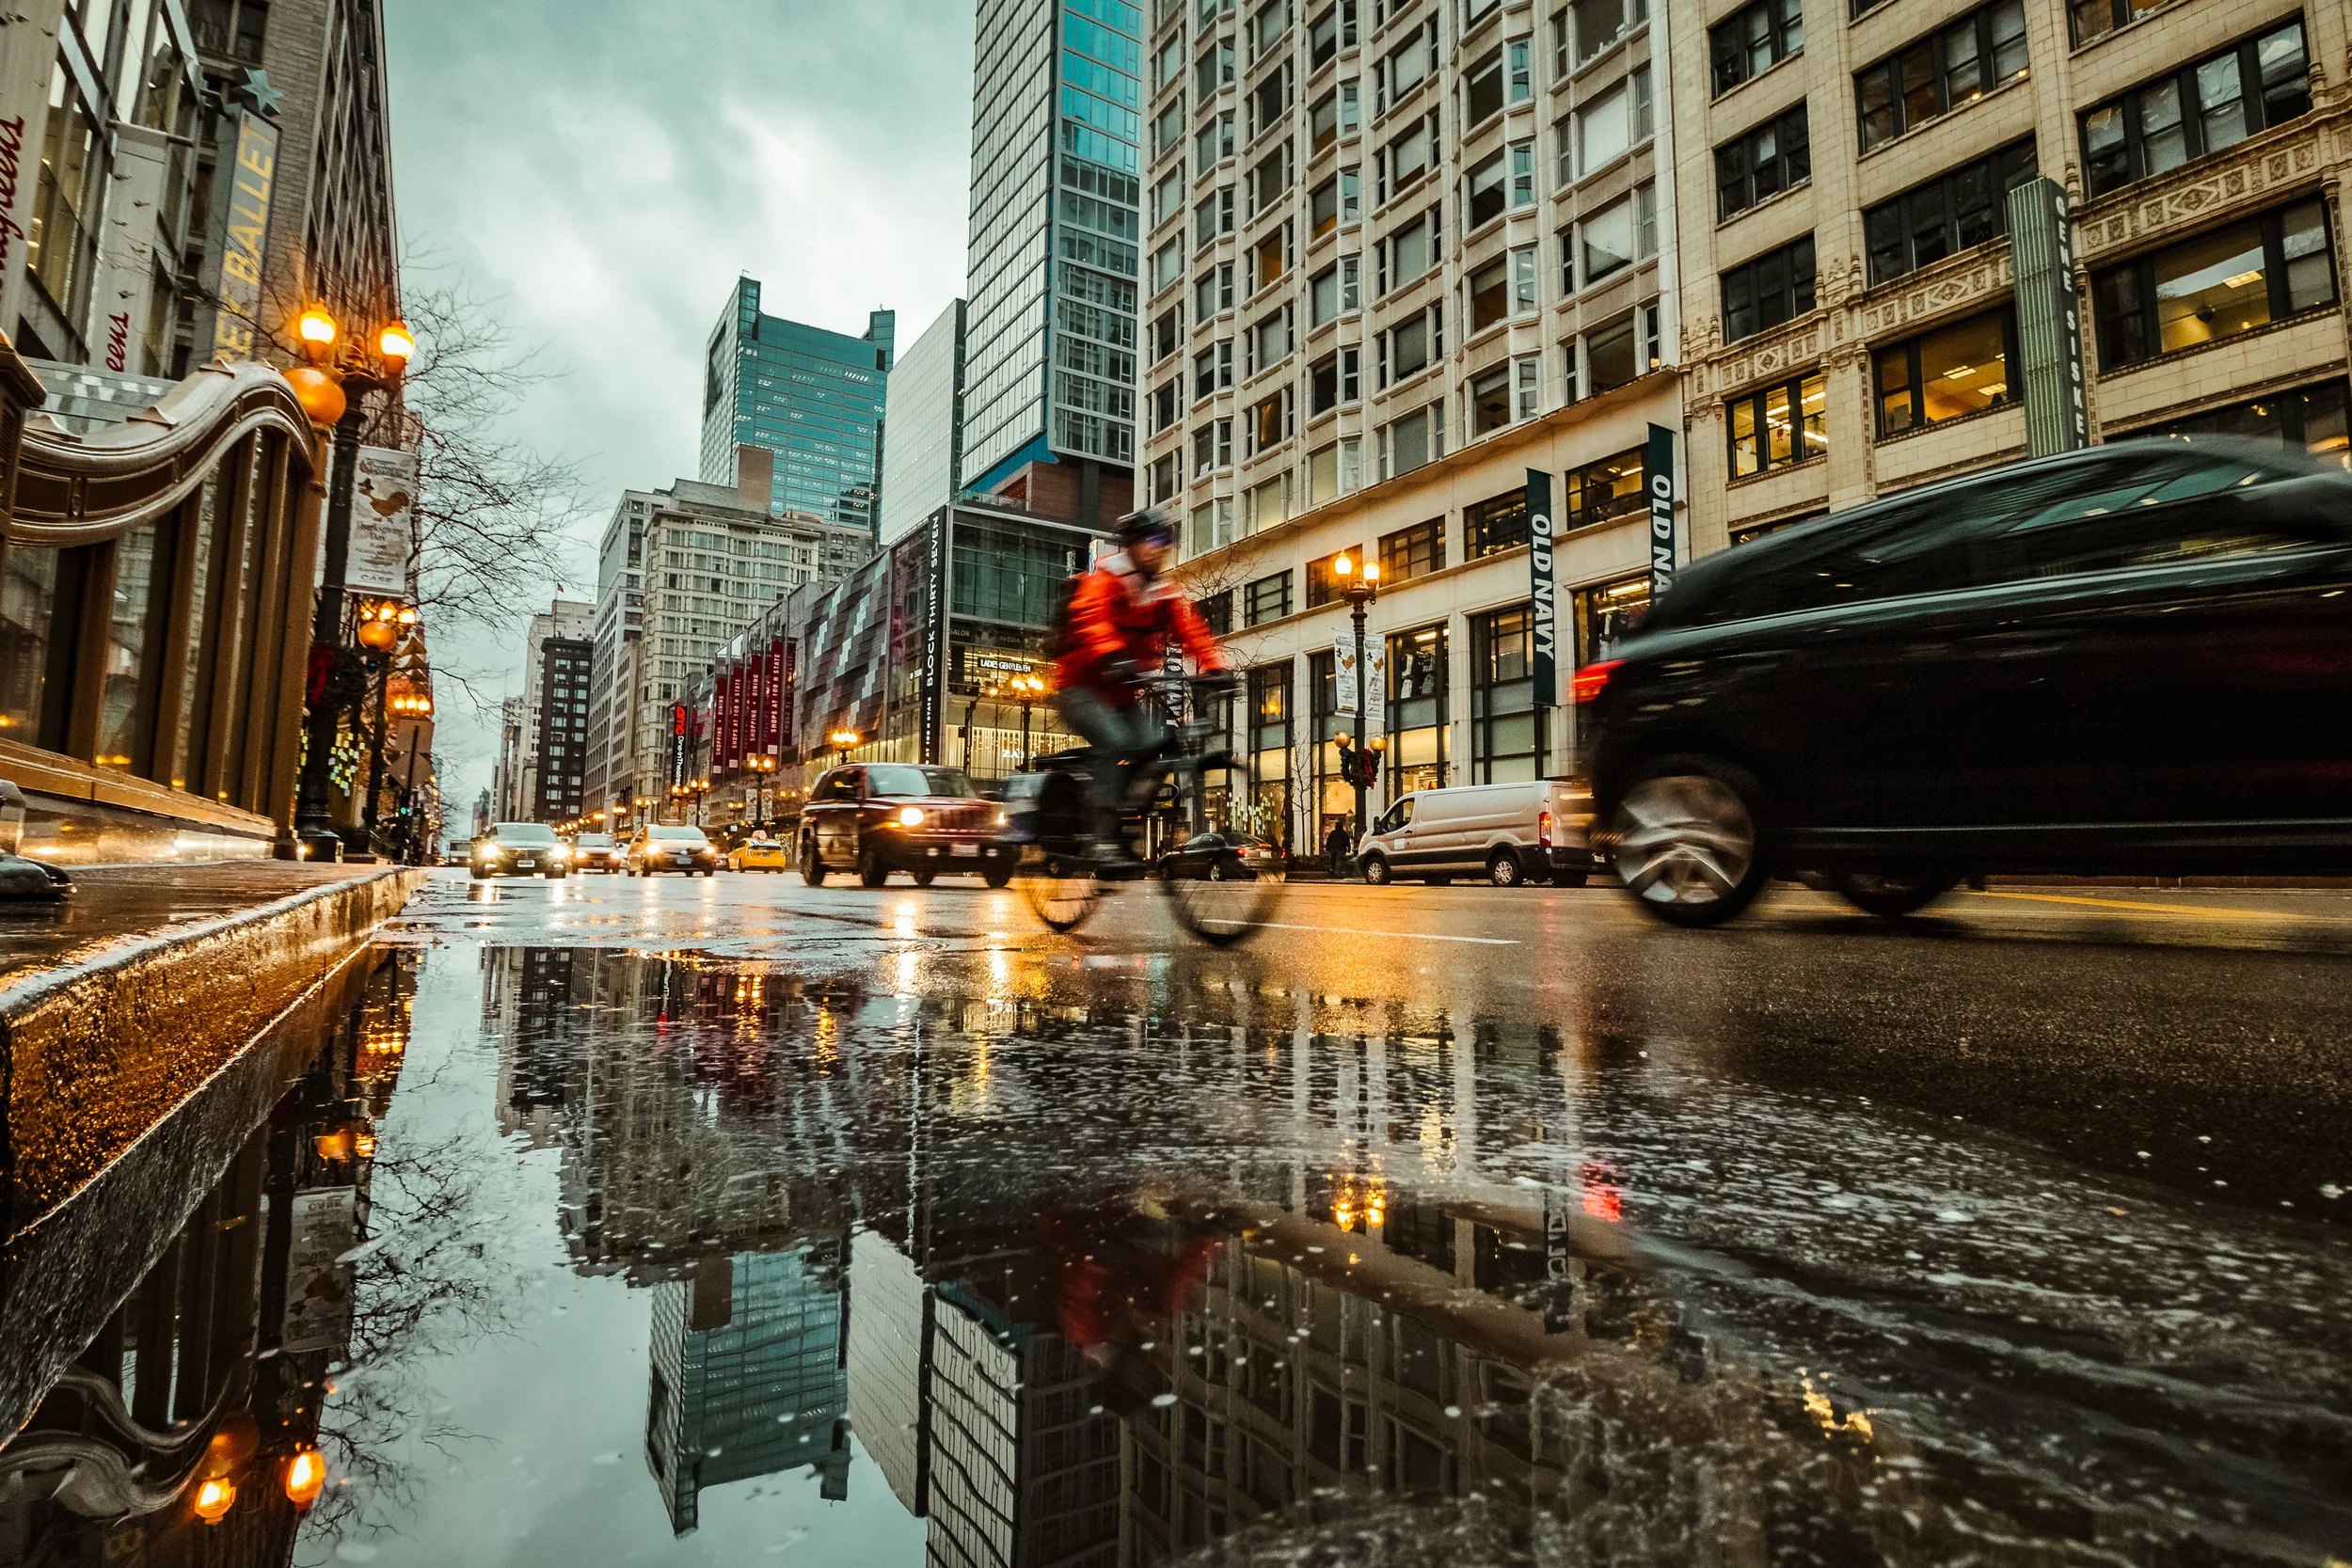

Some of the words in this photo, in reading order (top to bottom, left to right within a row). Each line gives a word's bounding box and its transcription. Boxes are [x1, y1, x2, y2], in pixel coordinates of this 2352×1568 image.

[223, 115, 275, 286] BALLET
[2055, 196, 2073, 293] GENE
[1652, 473, 1672, 540] OLD
[930, 515, 939, 568] SEVEN
[1532, 514, 1552, 573] OLD
[929, 573, 937, 627] THIRTY
[1653, 545, 1673, 603] NA
[948, 627, 970, 638] SALON
[999, 635, 1020, 643] AVEDA
[1534, 578, 1554, 660] NAVY
[926, 630, 936, 687] BLOCK
[979, 658, 998, 670] LADIES
[771, 700, 778, 708] AT
